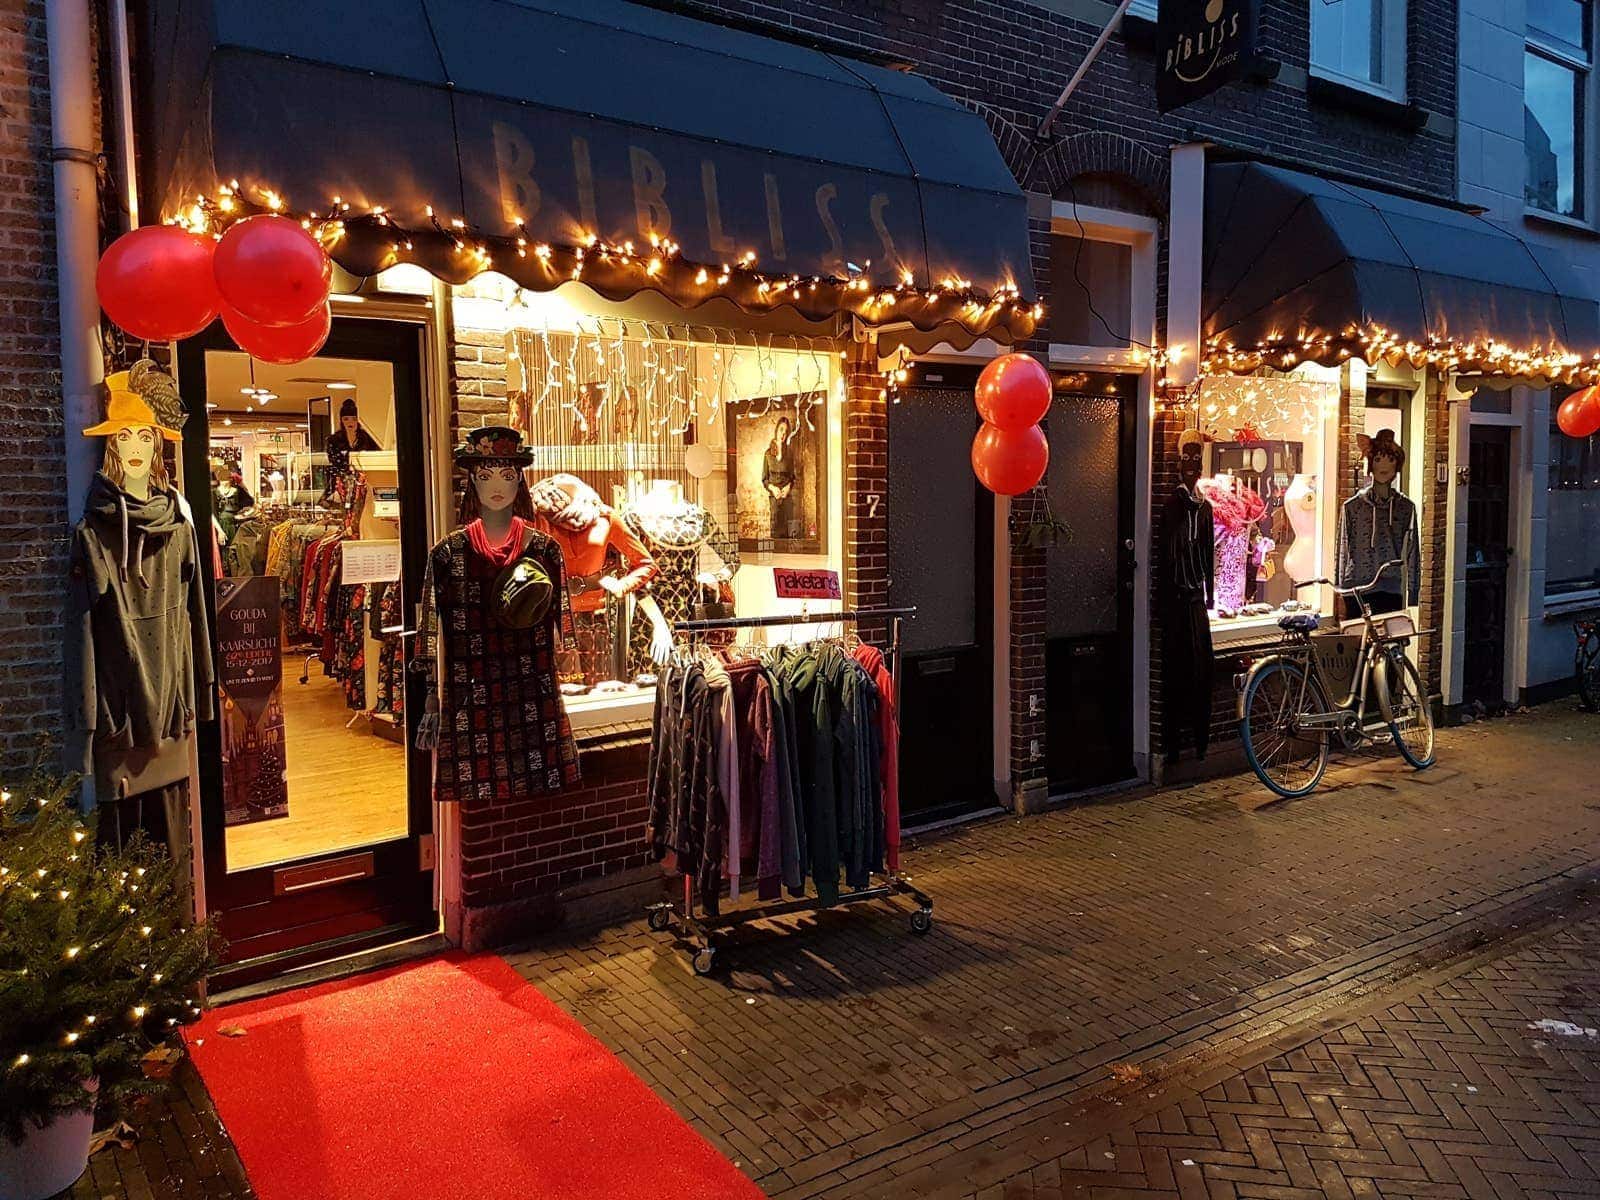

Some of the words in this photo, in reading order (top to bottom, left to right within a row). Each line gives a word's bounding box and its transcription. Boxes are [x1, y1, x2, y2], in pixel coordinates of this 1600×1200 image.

[491, 120, 900, 268] BIBLISS
[867, 495, 880, 518] 7
[230, 608, 267, 620] GOUDA
[243, 622, 255, 635] BIJ
